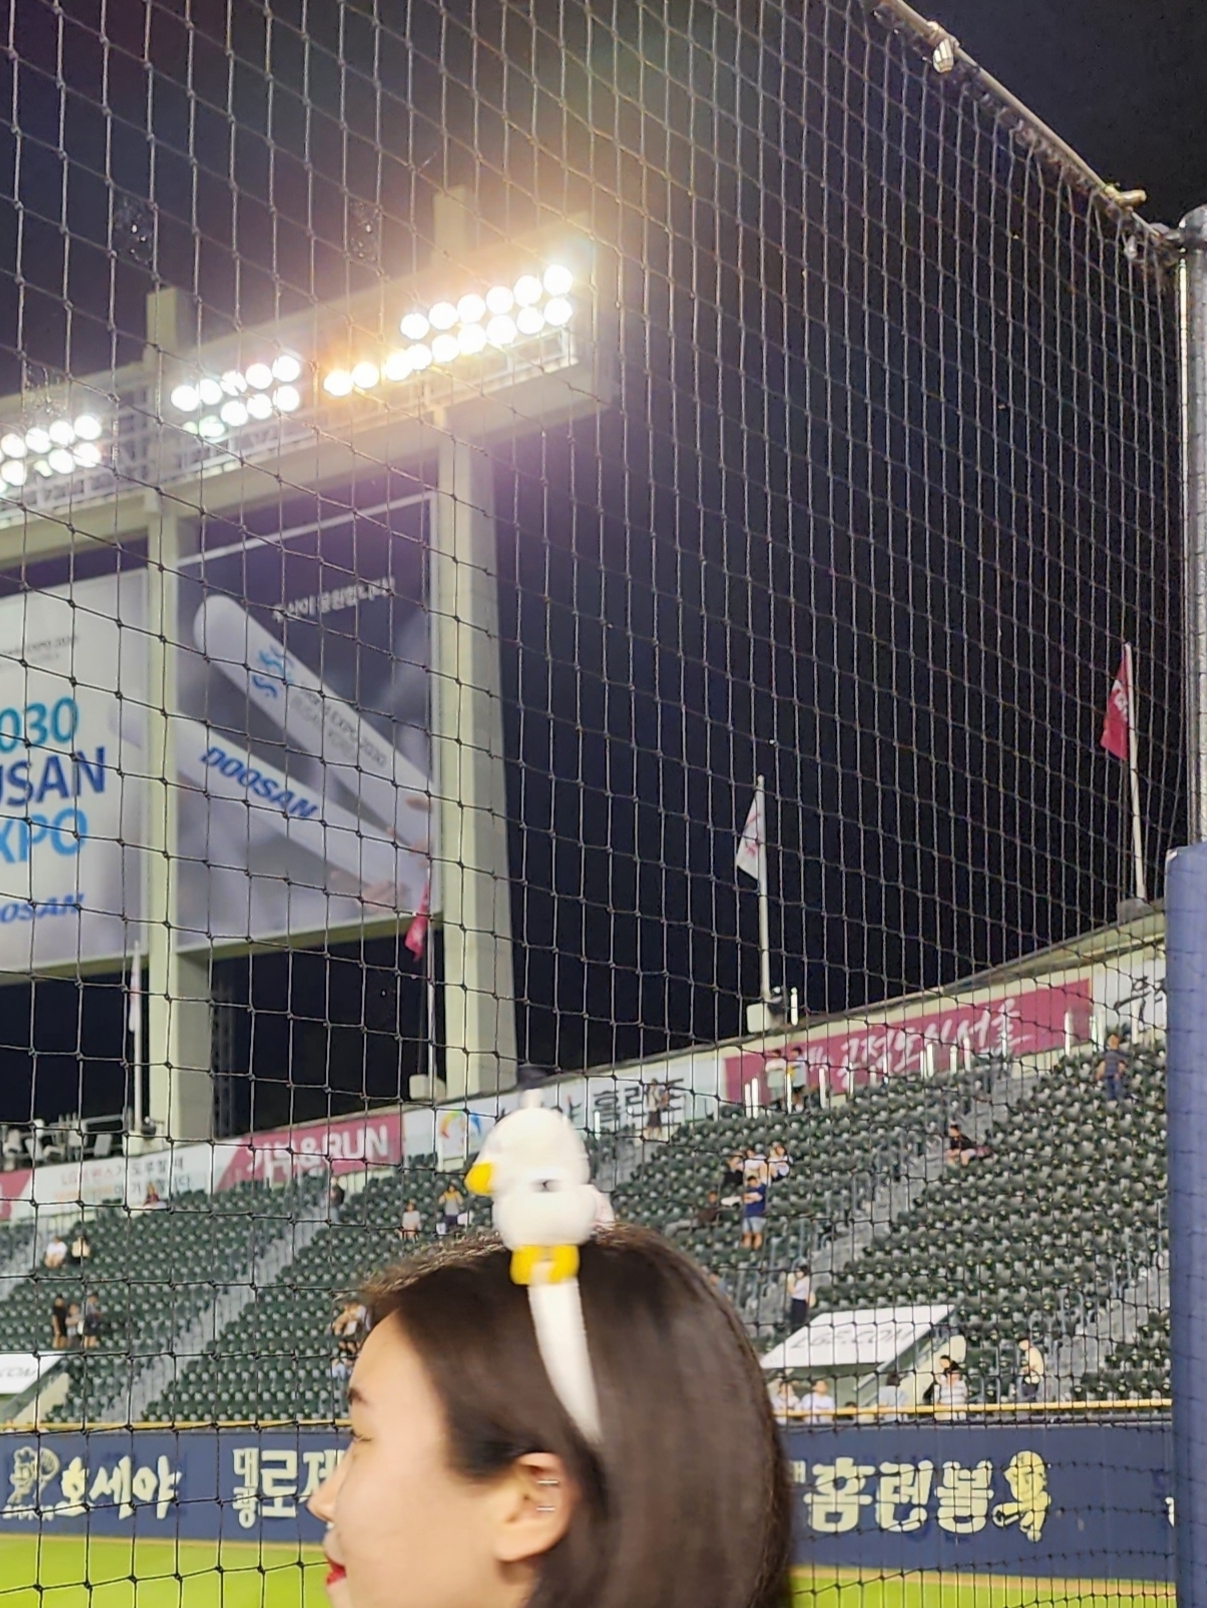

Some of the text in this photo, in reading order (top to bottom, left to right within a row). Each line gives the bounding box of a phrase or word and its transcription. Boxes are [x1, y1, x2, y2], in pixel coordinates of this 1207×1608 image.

[199, 746, 318, 818] DOOSAN
[54, 1454, 183, 1520] 호세야
[803, 1456, 995, 1534] 홈런볼
